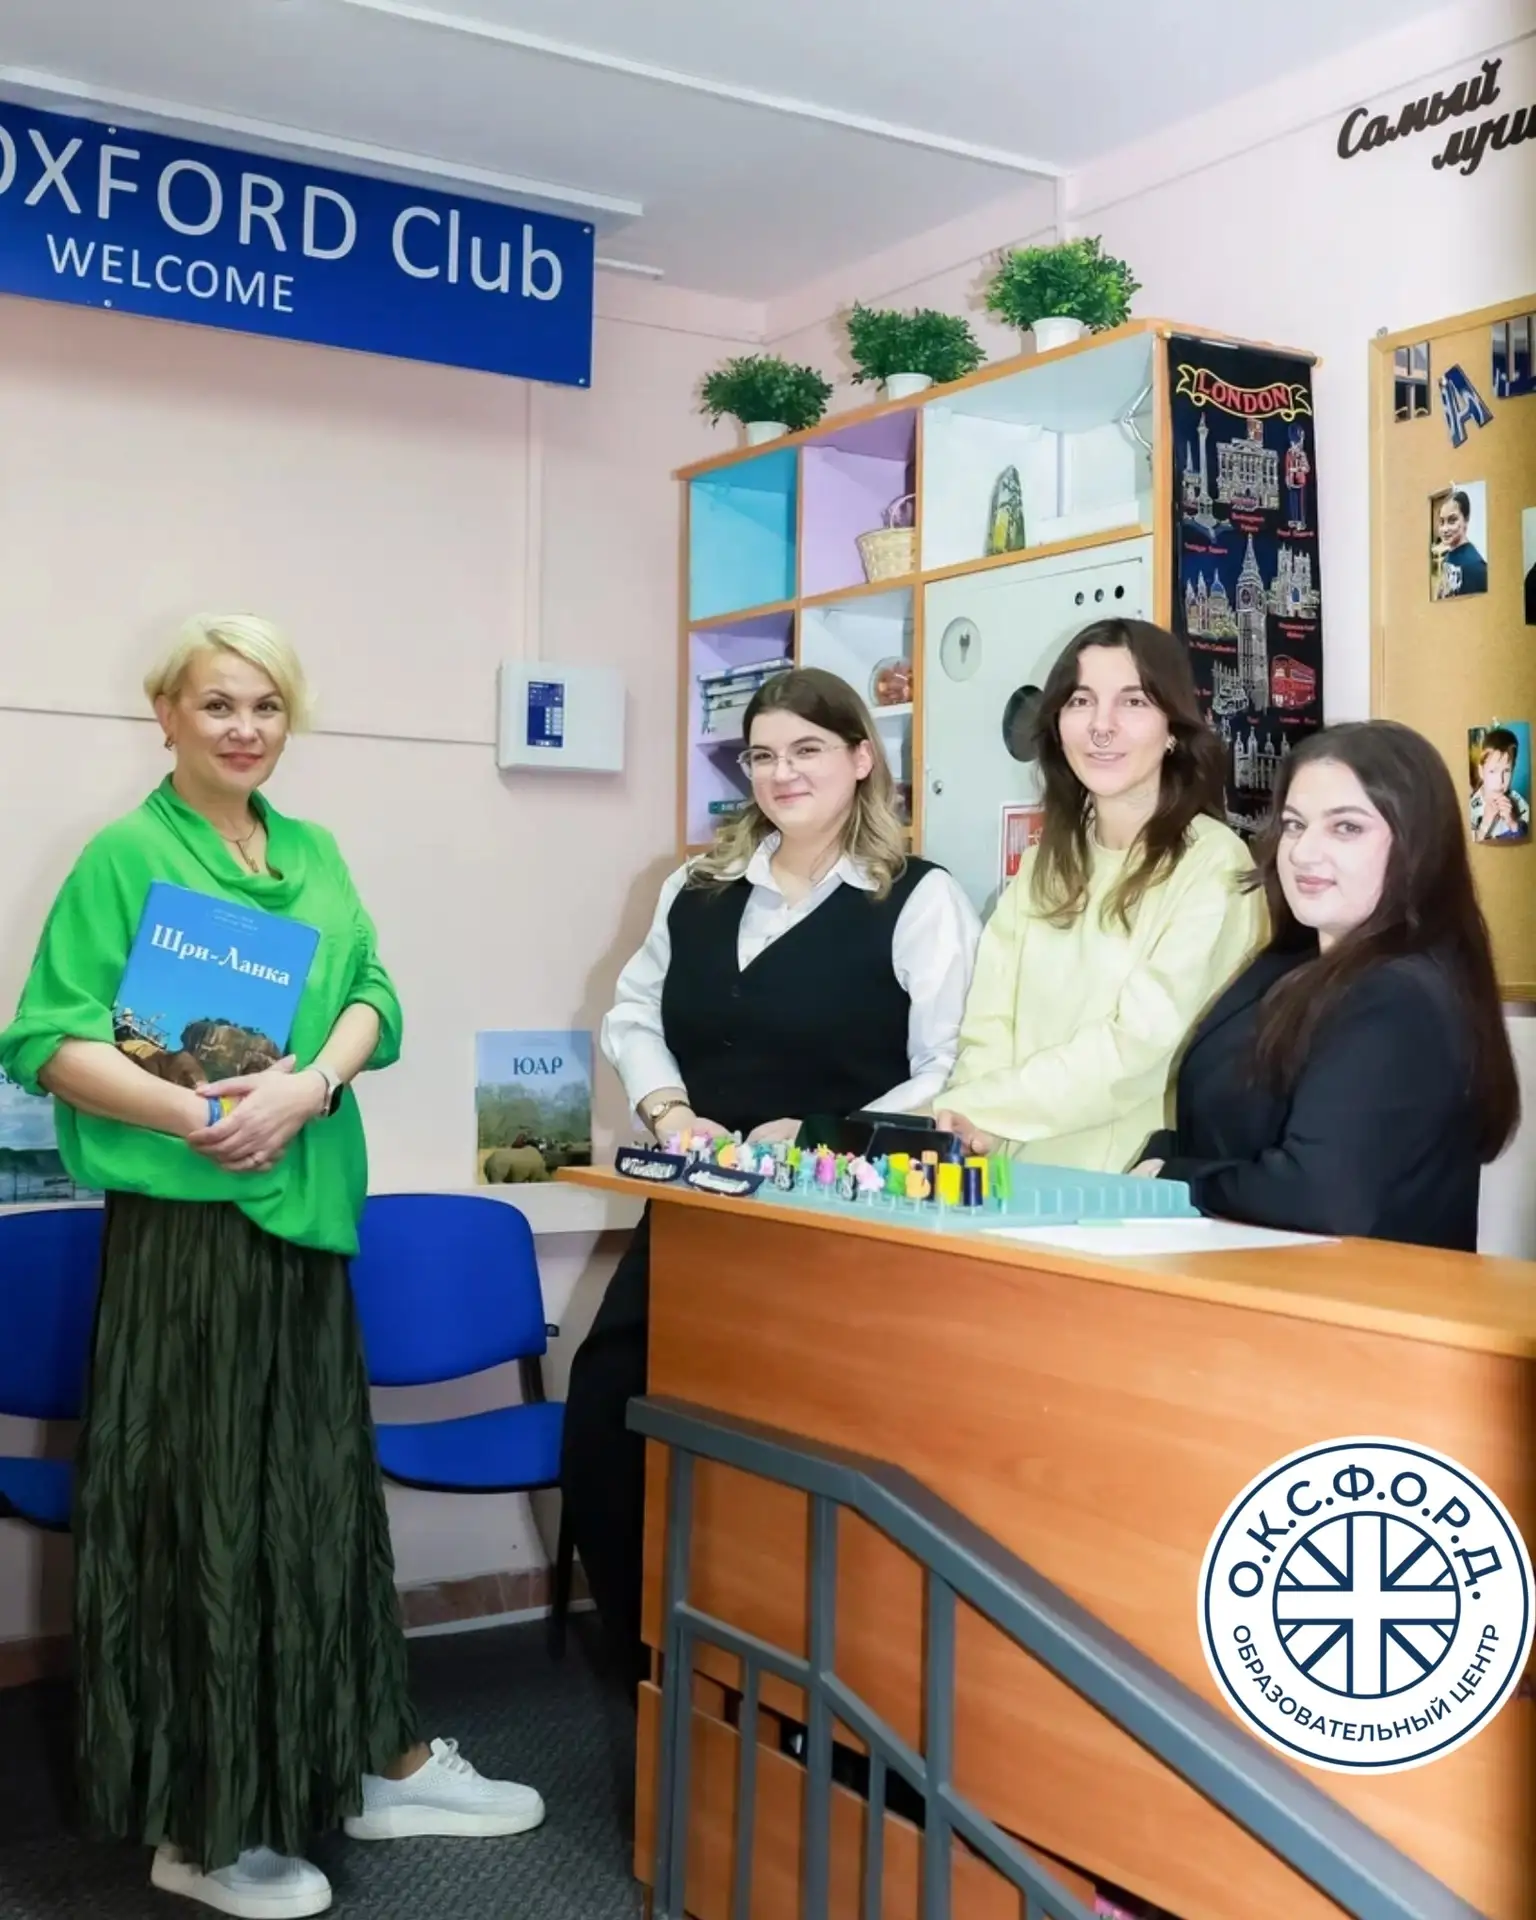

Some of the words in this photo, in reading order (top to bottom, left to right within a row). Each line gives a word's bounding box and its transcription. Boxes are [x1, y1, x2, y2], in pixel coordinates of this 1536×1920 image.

[1337, 58, 1502, 160] Самый
[0, 124, 357, 261] XFORD
[391, 206, 564, 302] Club
[46, 233, 295, 313] WELCOME
[1197, 371, 1289, 414] LONDON
[151, 923, 291, 986] Шри-Ланка
[513, 1055, 564, 1076] ЮАР
